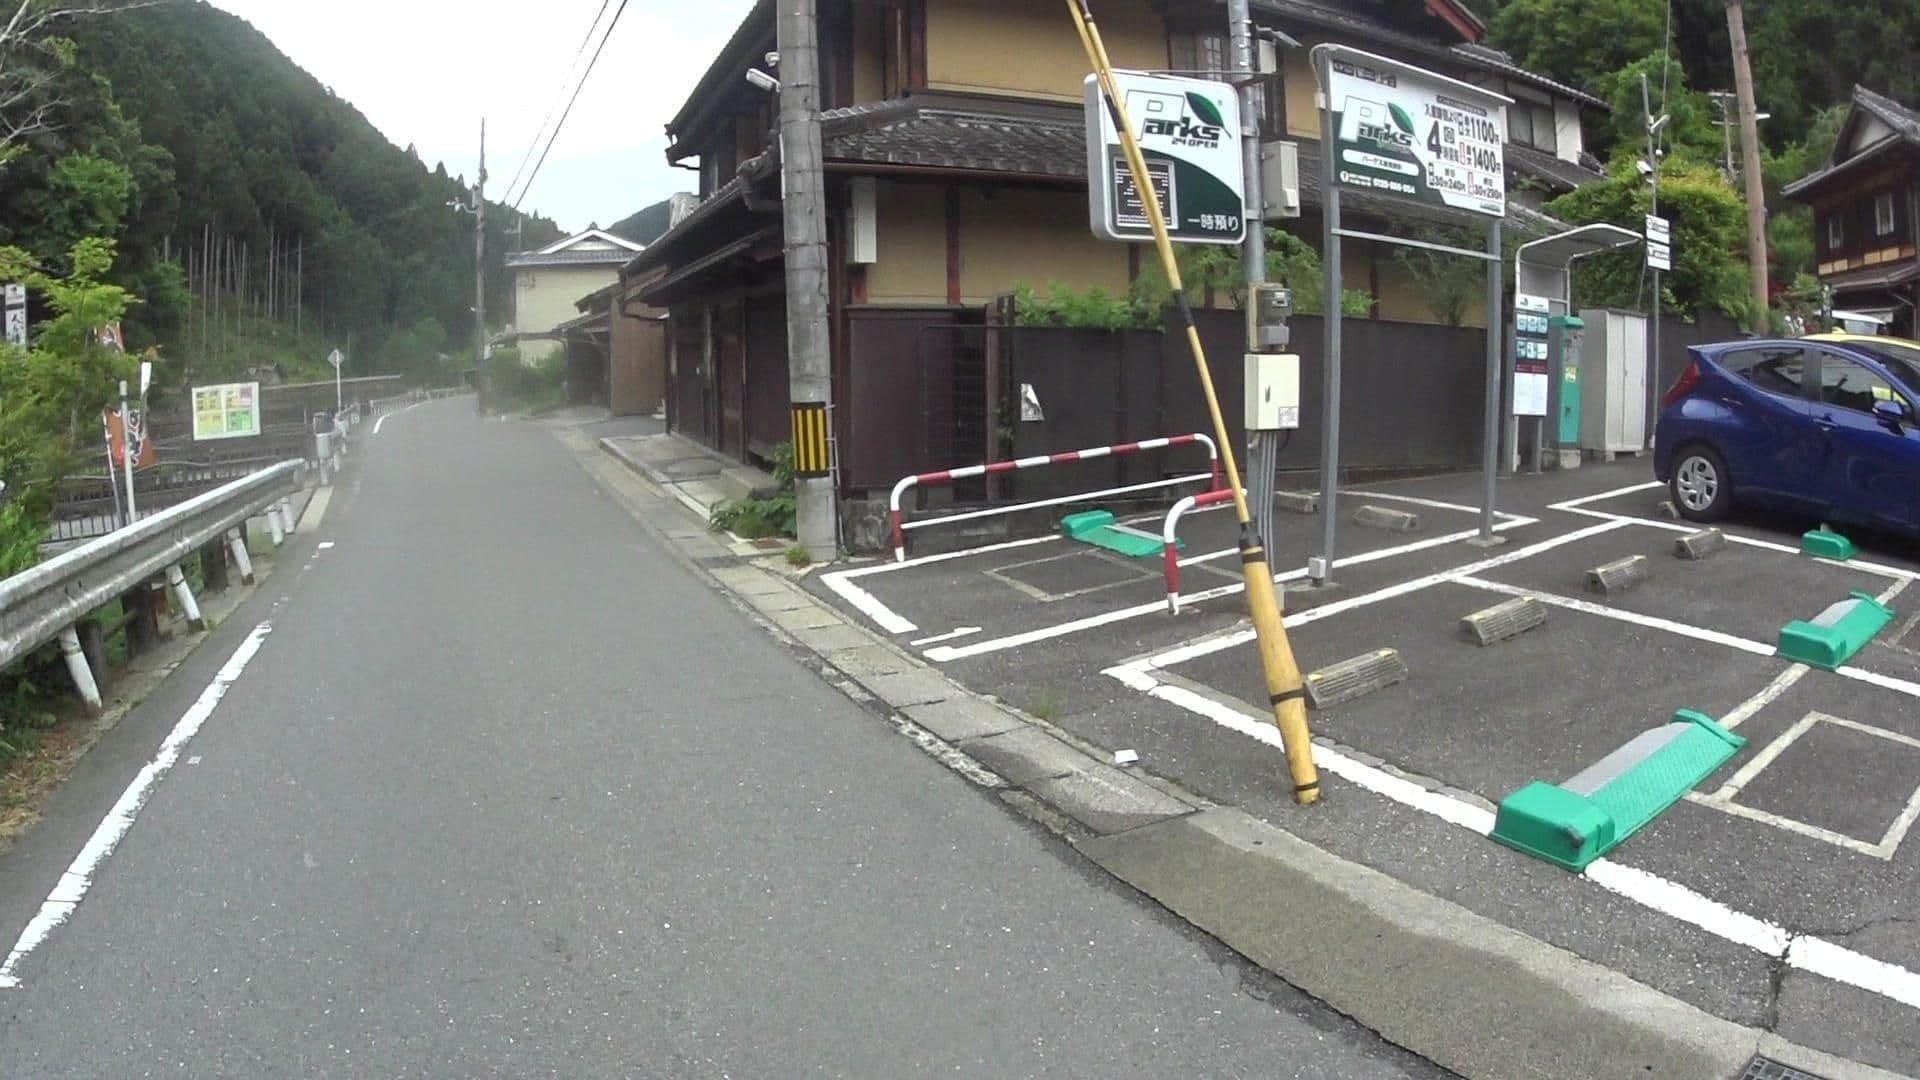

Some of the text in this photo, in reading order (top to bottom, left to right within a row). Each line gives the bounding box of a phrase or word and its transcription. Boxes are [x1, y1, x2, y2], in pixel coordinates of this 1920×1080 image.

[1187, 140, 1219, 149] OPEN
[1187, 213, 1239, 231] 一時預り
